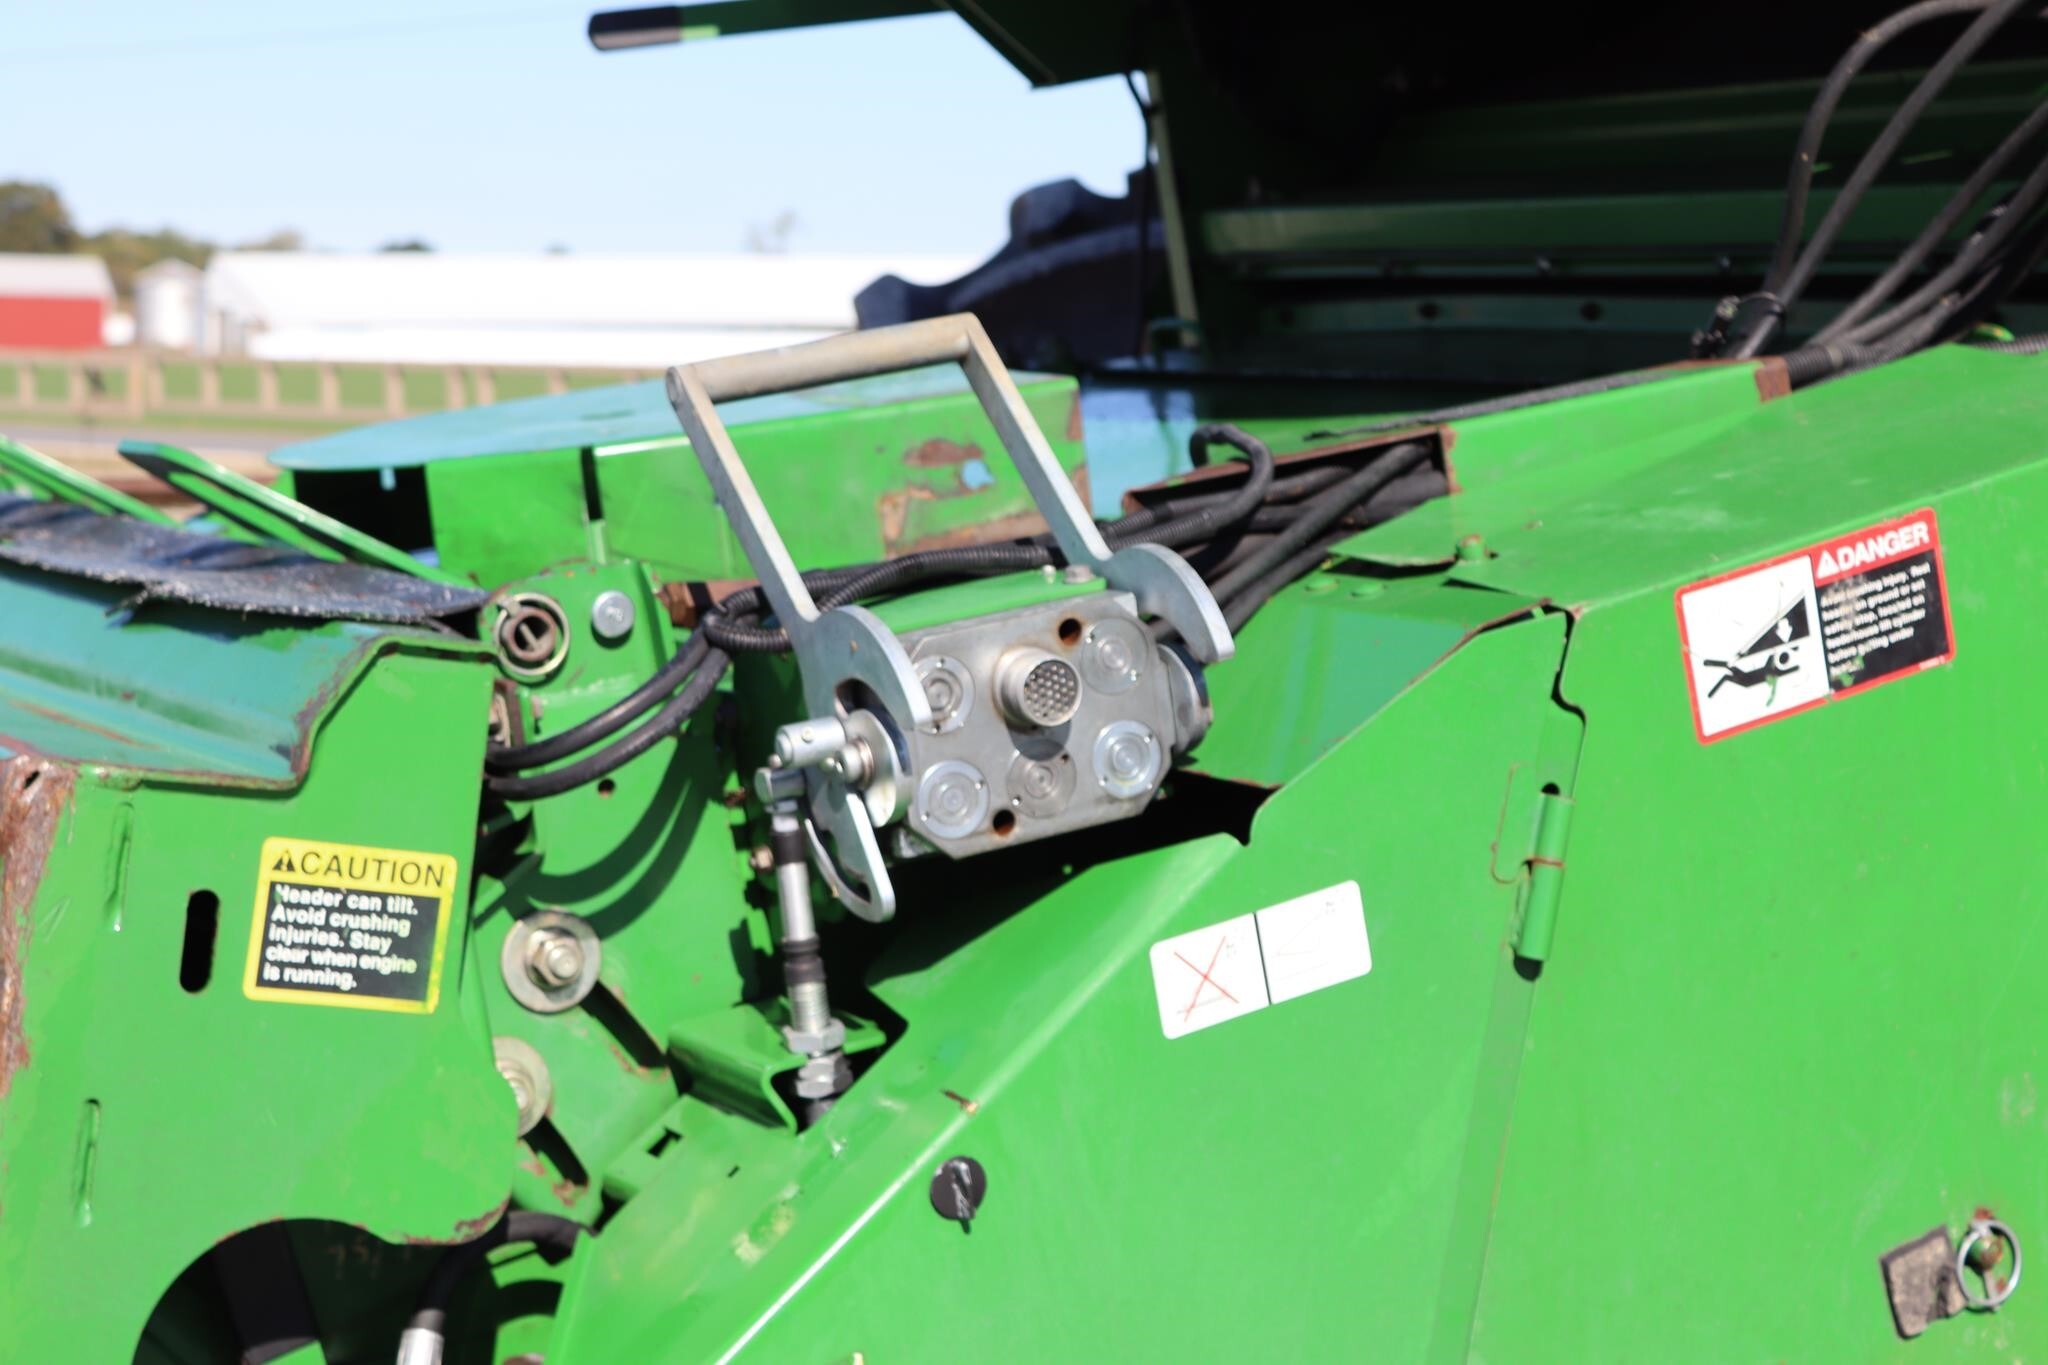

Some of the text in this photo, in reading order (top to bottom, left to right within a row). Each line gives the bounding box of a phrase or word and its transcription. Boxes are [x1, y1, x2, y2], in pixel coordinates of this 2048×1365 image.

[1837, 521, 1930, 571] DANGER
[1867, 587, 1900, 609] ground
[1899, 584, 1911, 596] or
[1877, 597, 1912, 618] located
[1912, 594, 1925, 606] on
[1892, 607, 1926, 628] cylinder
[1827, 646, 1858, 664] before
[1889, 626, 1915, 644] under
[301, 851, 445, 888] CAUTION
[275, 884, 418, 915] Header can tilt.
[271, 903, 411, 938] Avoid crushing
[268, 922, 393, 955] injuries. Stay
[265, 944, 417, 975] clear when engine
[263, 962, 358, 991] is running.
